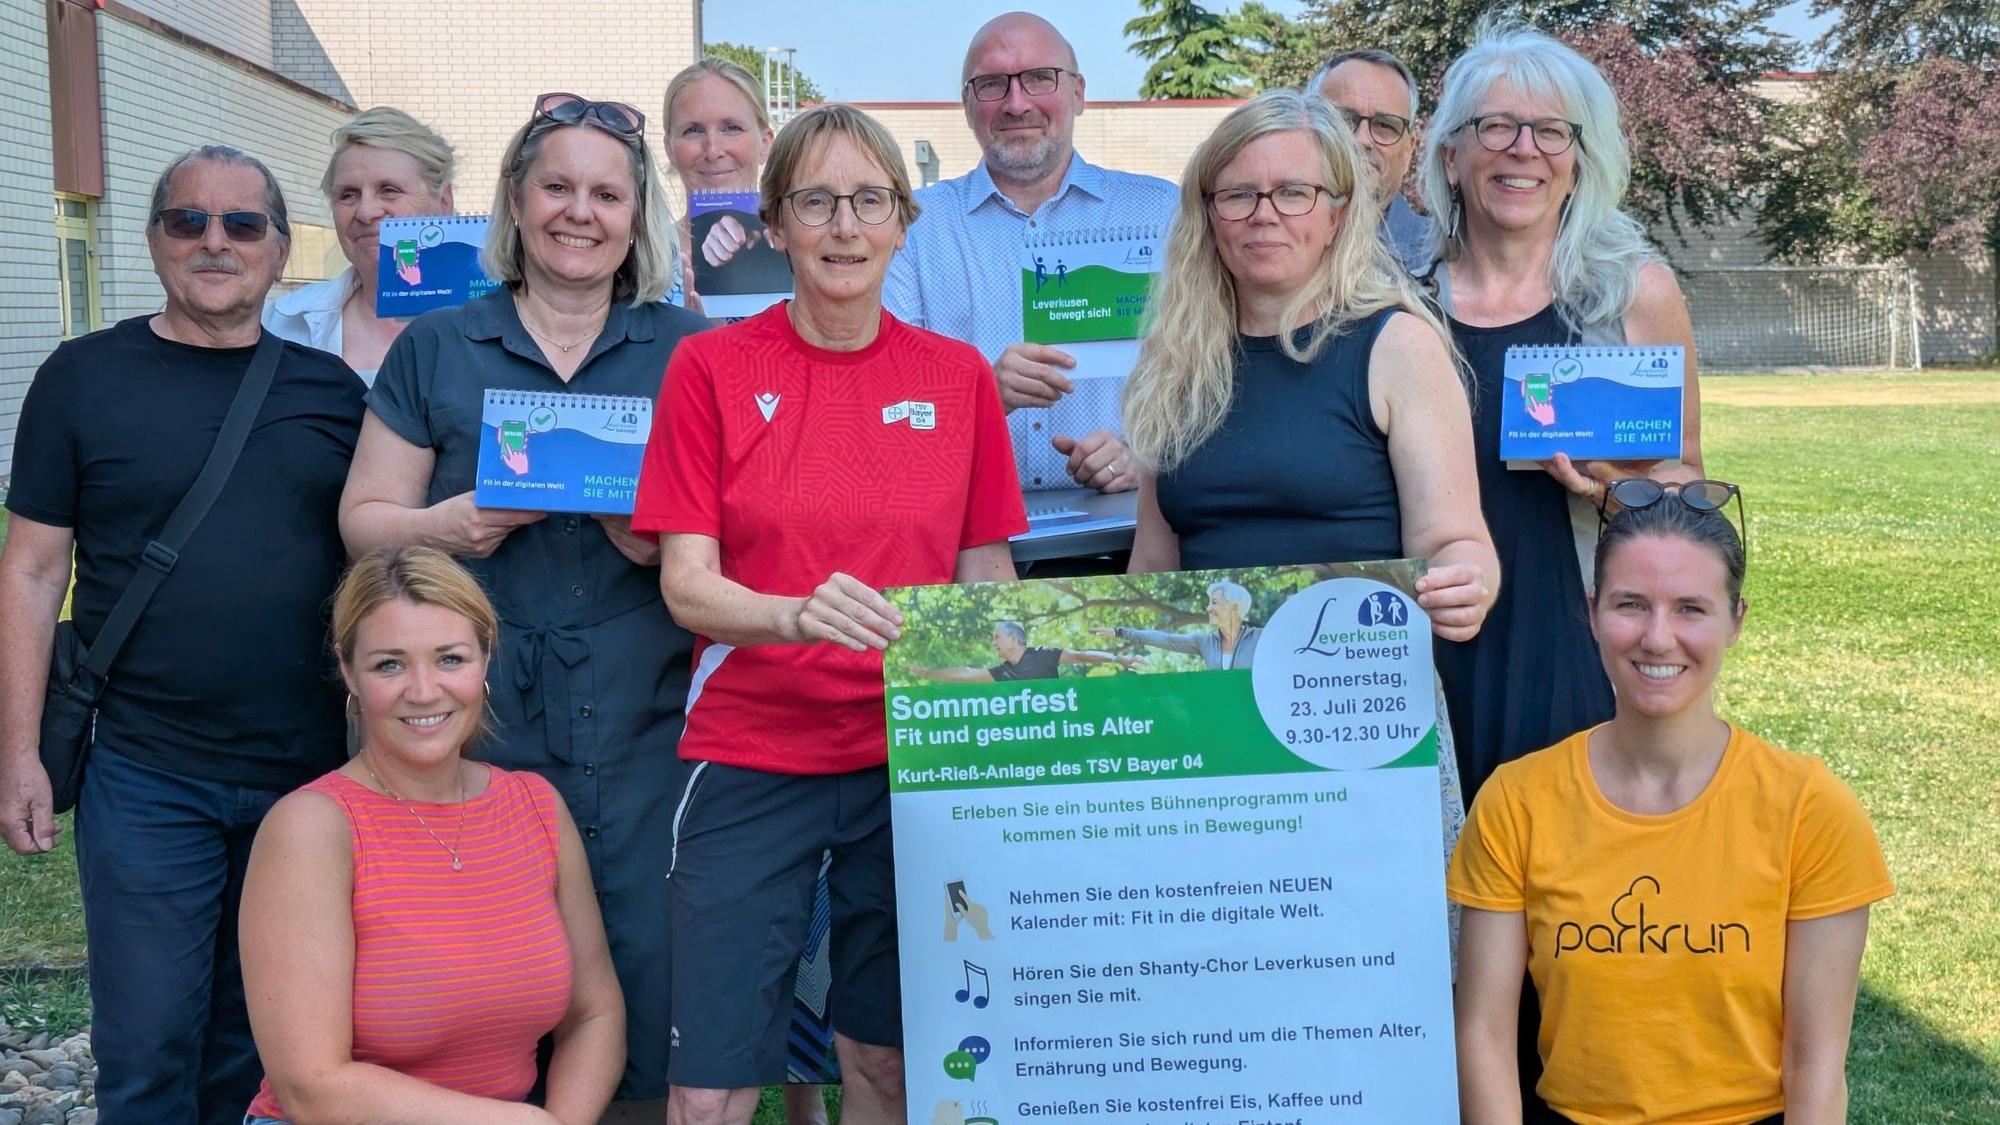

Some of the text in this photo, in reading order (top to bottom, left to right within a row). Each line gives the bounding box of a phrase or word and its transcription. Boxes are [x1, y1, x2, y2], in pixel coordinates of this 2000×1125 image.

[1033, 299, 1088, 309] Leverkusen
[1050, 308, 1111, 320] bewegt sich!
[1542, 431, 1574, 439] digitalen
[1615, 420, 1671, 429] MACHEN
[1614, 433, 1671, 443] SIE MIT!
[515, 481, 545, 489] digitalen
[584, 476, 637, 486] MACHEN
[584, 489, 603, 498] SIE
[1293, 598, 1408, 657] Leverkusen
[1345, 645, 1409, 660] bewegt
[1293, 671, 1407, 689] Donnerstag,
[892, 688, 1078, 721] Sommerfest
[1290, 697, 1406, 717] 23. Juli 2026
[895, 717, 1154, 747] Fit und gesund ins Alter
[1286, 724, 1420, 744] 9.30-12.30 Uhr
[898, 754, 1203, 783] Kurt-Rieß-Anlage des TSV Bayer 04
[952, 788, 1347, 820] Erleben Sie ein buntes Bühnenprogramm und
[1003, 816, 1303, 843] kommen Sie mit uns in Bewegung!
[1010, 877, 1332, 905] Nehmen Sie den kostenfreien NEUEN
[1011, 903, 1324, 930] Kalender mit: Fit in die digitale Welt.
[1554, 902, 1750, 958] parkrun
[1013, 952, 1395, 981] Hören Sie den Shanty-Chor Leverkusen und
[1014, 987, 1141, 1008] singen Sie mit.
[1014, 1023, 1426, 1052] Informieren Sie sich rund um die Themen Alter,
[1016, 1055, 1247, 1077] Ernährung und Bewegung.
[1018, 1091, 1362, 1116] Genießen Sie kostenfrei Eis, Kaffee und
